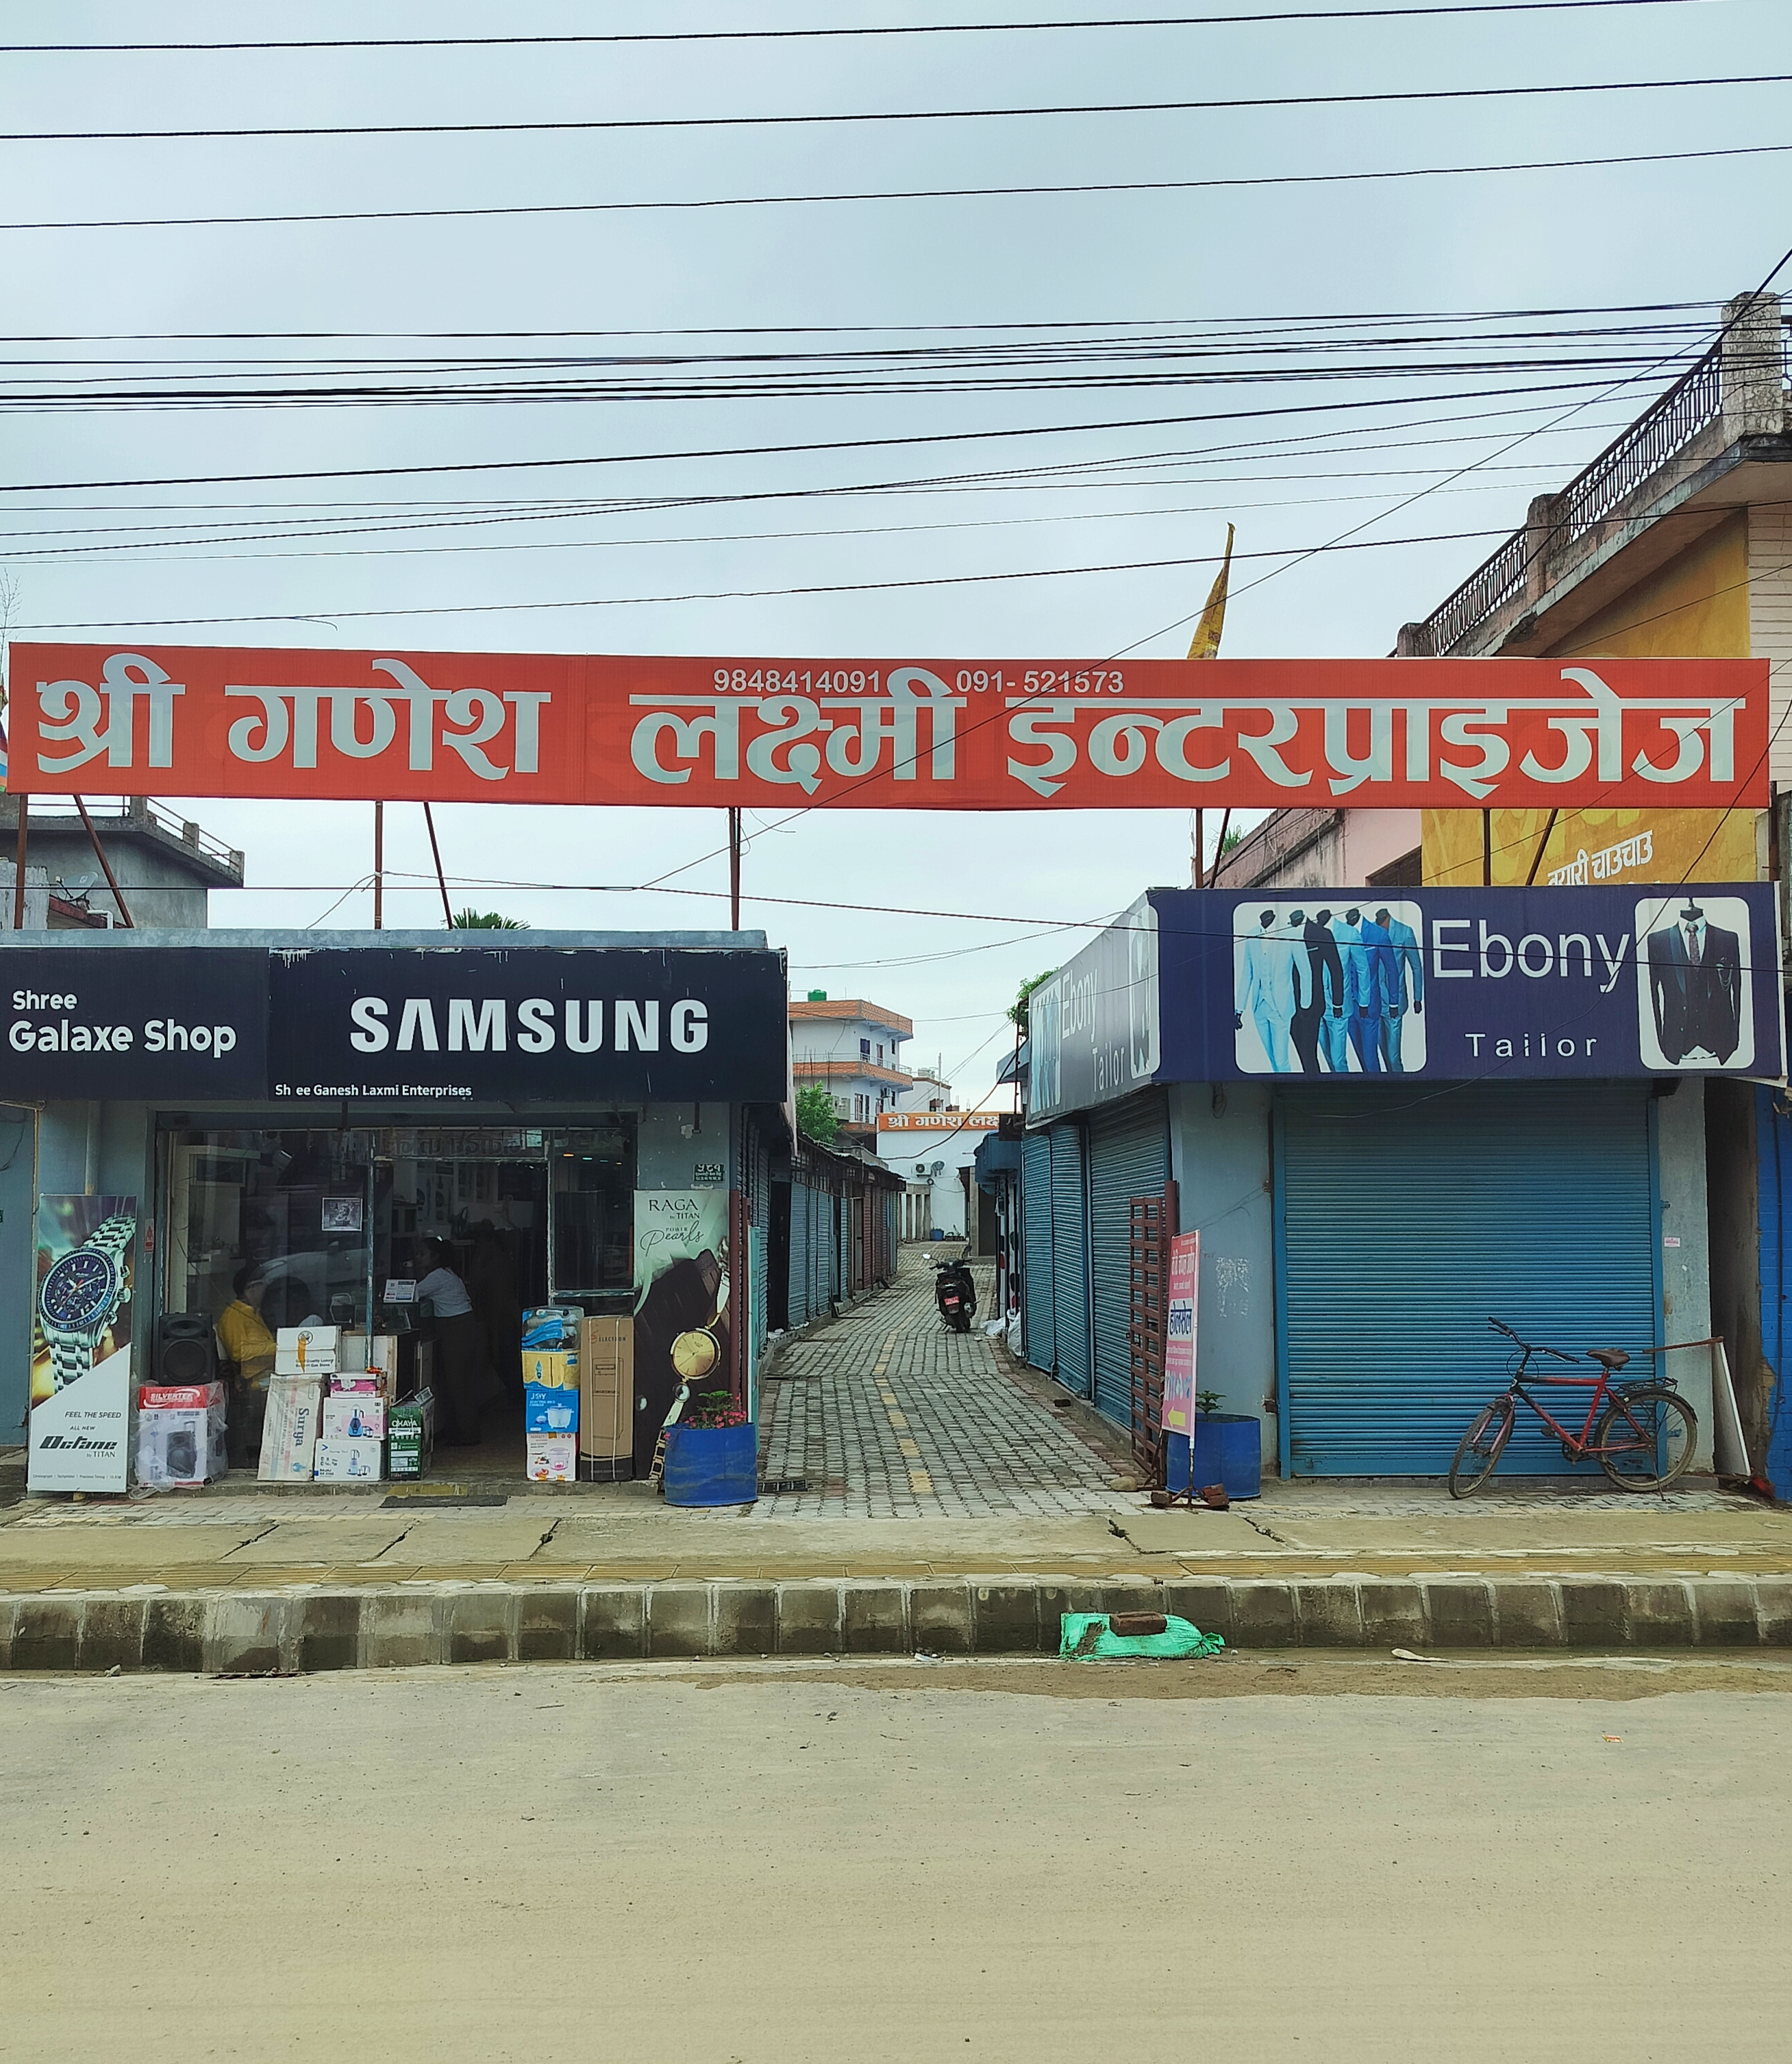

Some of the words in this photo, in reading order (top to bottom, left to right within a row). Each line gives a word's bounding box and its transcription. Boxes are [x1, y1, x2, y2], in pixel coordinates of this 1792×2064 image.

[713, 669, 880, 693] 9848414091
[1023, 671, 1125, 694] 521573
[36, 653, 186, 774] श्री
[224, 658, 552, 781] गणेश
[629, 667, 967, 796] लक्ष्मी
[1005, 667, 1747, 799] इन्टरप्राइजेज
[1591, 830, 1654, 880] चाउचाउ
[1432, 919, 1631, 994] Ebony
[12, 990, 78, 1010] Shree
[1062, 968, 1097, 1043] Ebony
[9, 1019, 134, 1052] Galaxe
[144, 1019, 237, 1058] Shop
[350, 997, 709, 1054] SAMSUNG
[1465, 1032, 1598, 1058] Tailor
[1092, 1041, 1125, 1093] Tailor
[313, 1084, 360, 1097] Ganesh
[362, 1084, 399, 1097] Laxmi
[402, 1084, 472, 1099] Enterprises
[887, 1113, 910, 1128] श्री
[915, 1113, 963, 1127] गणेश
[649, 1199, 699, 1211] RAGA
[640, 1220, 705, 1257] Pearls
[39, 1436, 118, 1450] Octane
[293, 1408, 310, 1447] Surya
